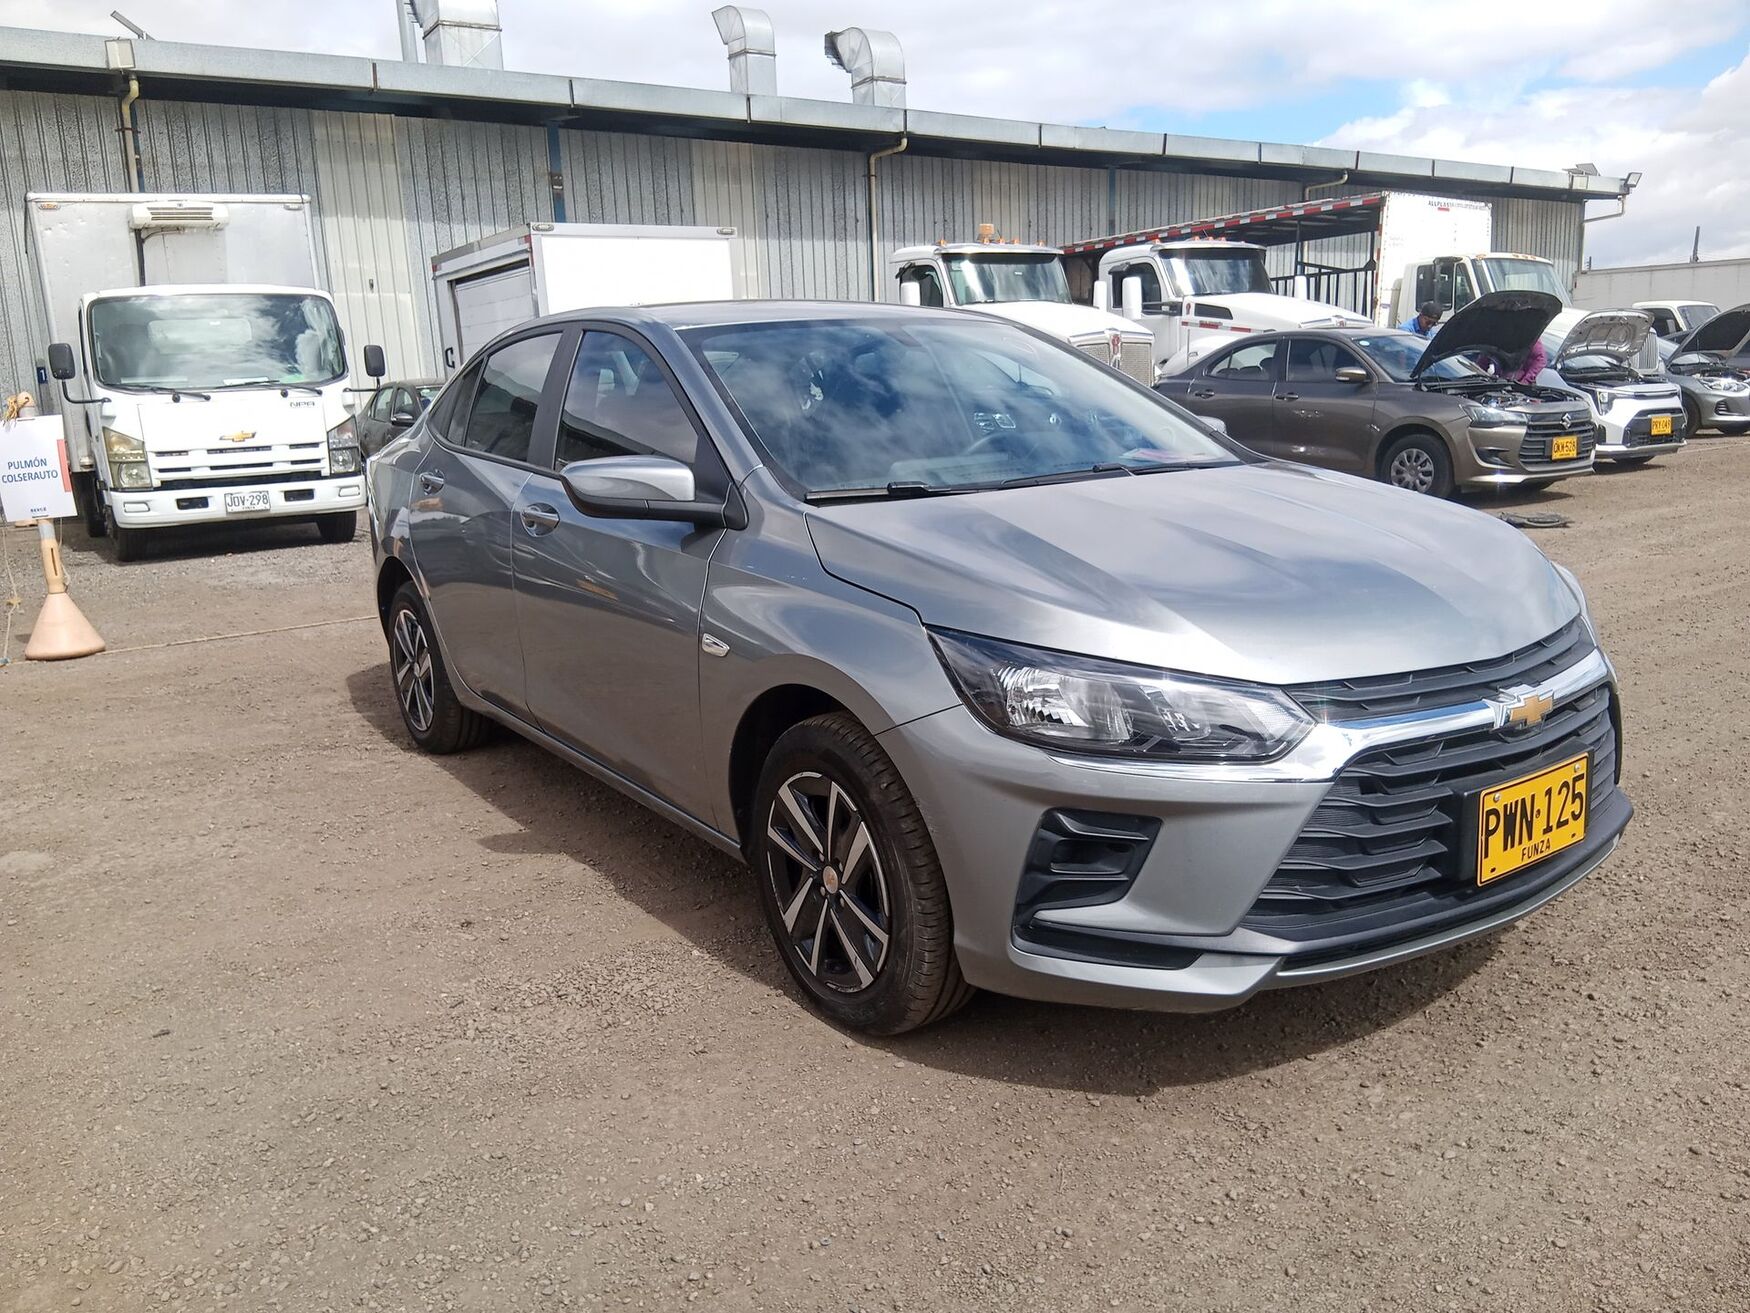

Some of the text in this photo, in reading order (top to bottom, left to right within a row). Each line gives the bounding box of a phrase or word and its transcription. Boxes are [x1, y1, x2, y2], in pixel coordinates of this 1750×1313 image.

[8, 456, 47, 470] PULMÓN
[1, 469, 59, 484] COLSERAUTO
[1521, 838, 1551, 862] FUNZA
